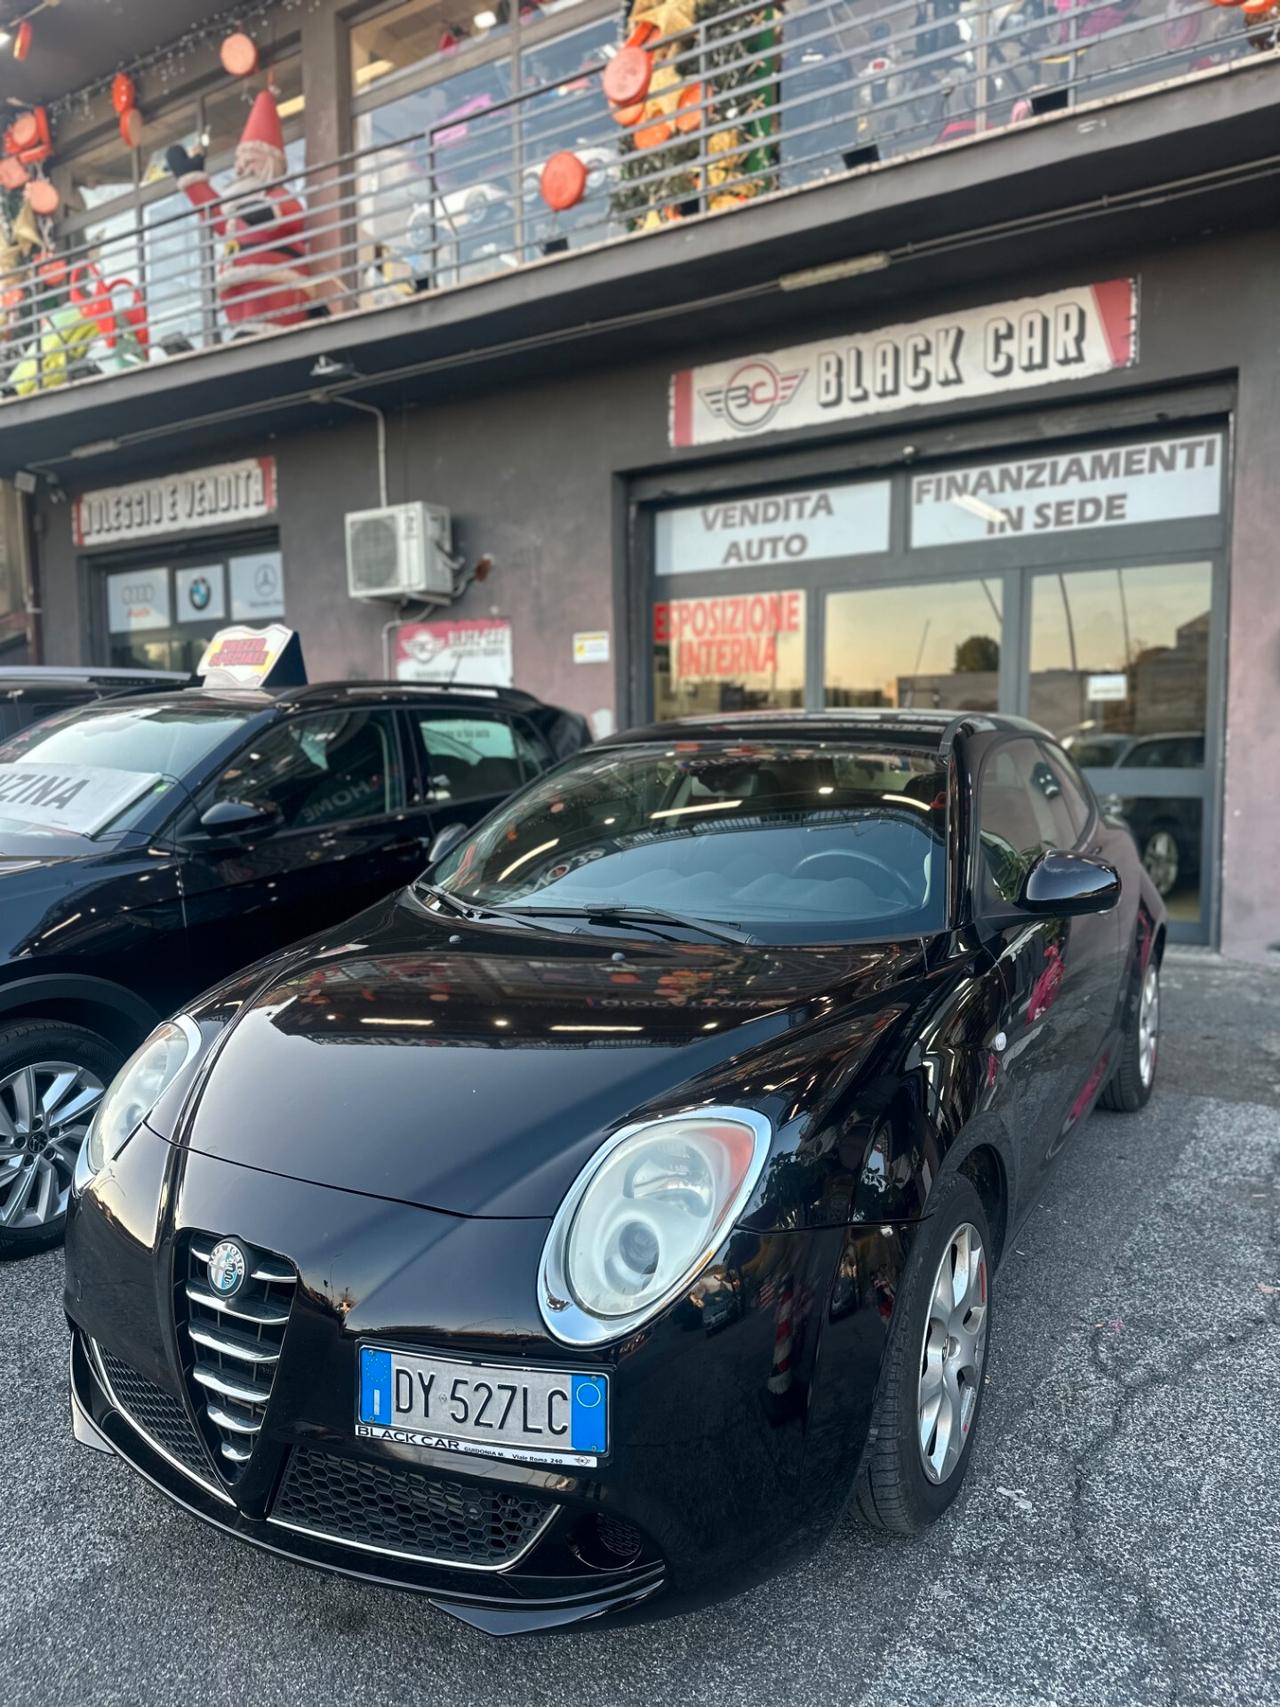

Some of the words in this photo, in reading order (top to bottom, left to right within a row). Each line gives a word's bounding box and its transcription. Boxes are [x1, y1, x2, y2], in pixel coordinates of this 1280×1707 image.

[818, 325, 964, 409] BLACK
[984, 302, 1086, 378] CAR
[183, 468, 265, 518] VENDITA
[914, 438, 1216, 505] FINANZIAMENTI
[701, 493, 834, 531] VENDITA
[986, 506, 1024, 535] IN
[1033, 494, 1128, 530] SEDE
[722, 533, 808, 565] AUTO
[654, 592, 801, 642] ESPOSIZIONE
[677, 635, 779, 679] INTERNA
[395, 1367, 436, 1418] DY
[450, 1377, 569, 1437] 527LC
[358, 1426, 417, 1443] BLACK
[421, 1436, 460, 1450] CAR
[512, 1453, 528, 1461] Viale
